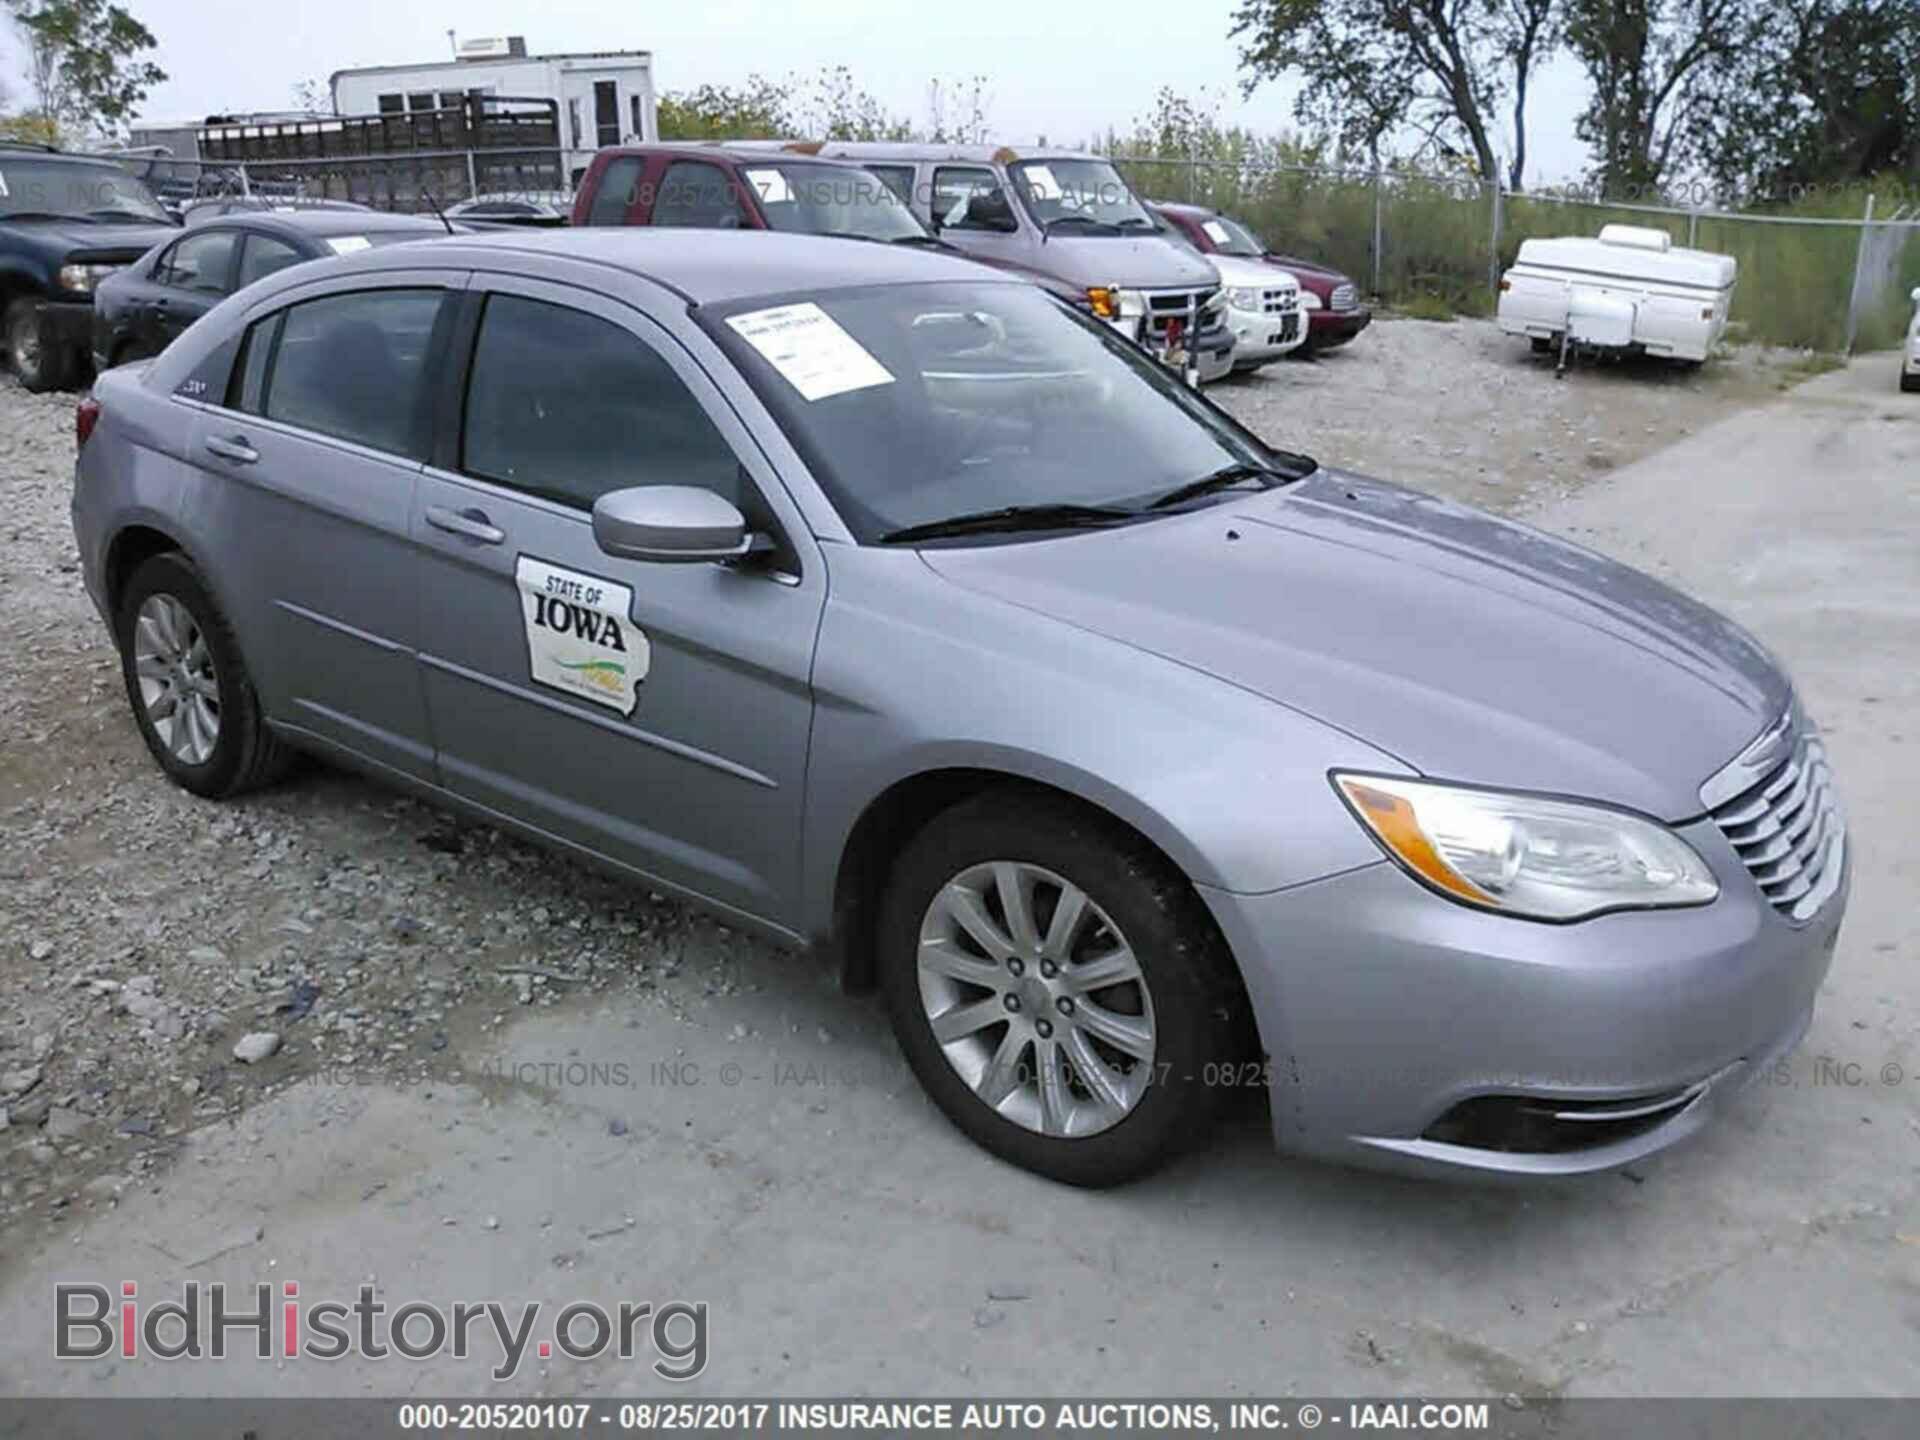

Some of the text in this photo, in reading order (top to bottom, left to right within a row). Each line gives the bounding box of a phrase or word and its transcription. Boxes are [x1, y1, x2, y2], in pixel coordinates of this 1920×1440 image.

[545, 575, 604, 606] STATE OF
[532, 591, 627, 653] IOWA
